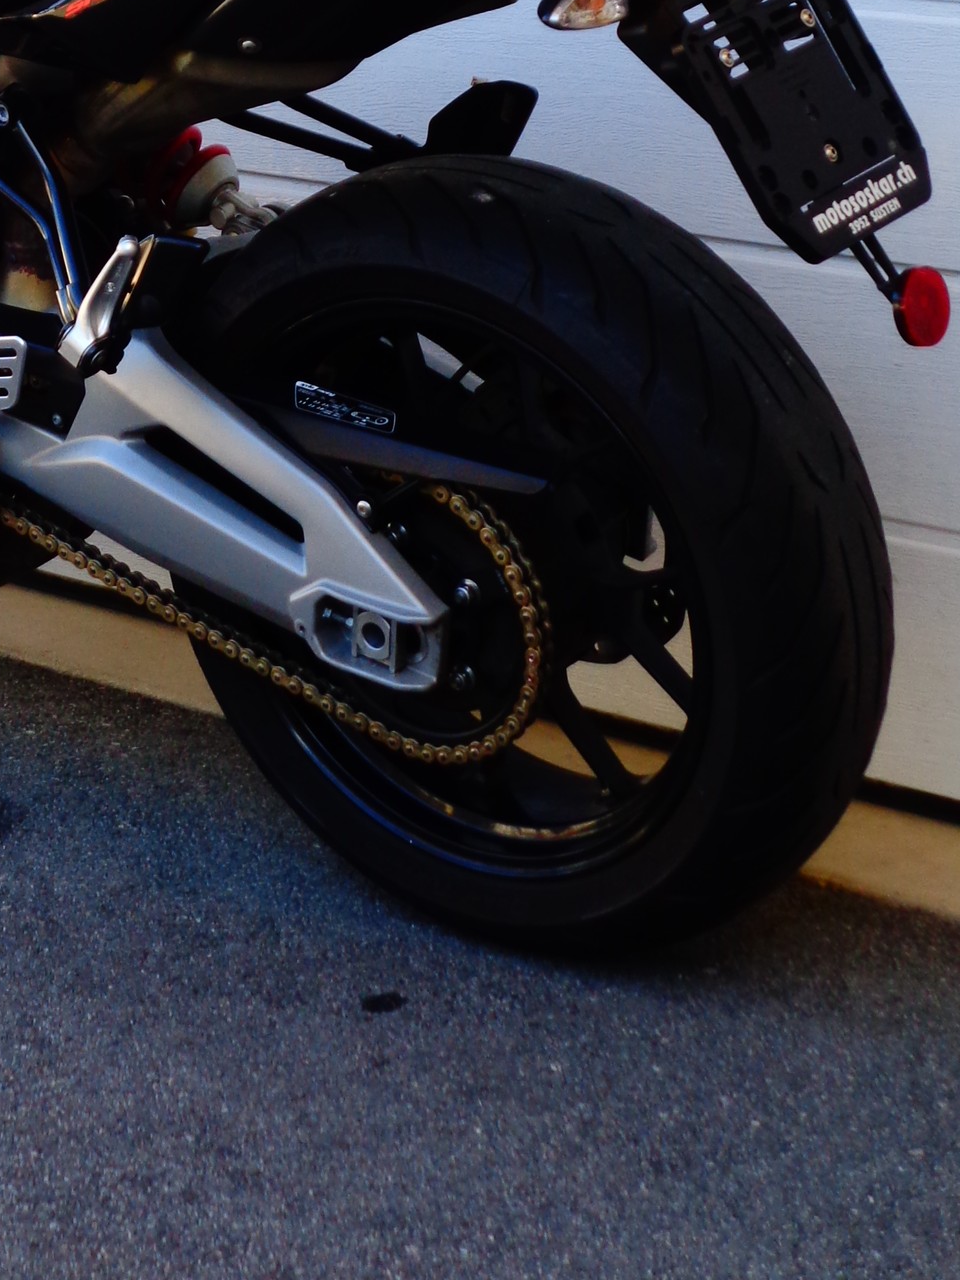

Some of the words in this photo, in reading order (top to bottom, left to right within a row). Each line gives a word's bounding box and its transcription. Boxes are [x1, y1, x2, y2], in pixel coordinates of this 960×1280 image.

[811, 160, 918, 235] motososkar.ch
[848, 214, 871, 235] 3952
[869, 196, 902, 222] SUSTEN
